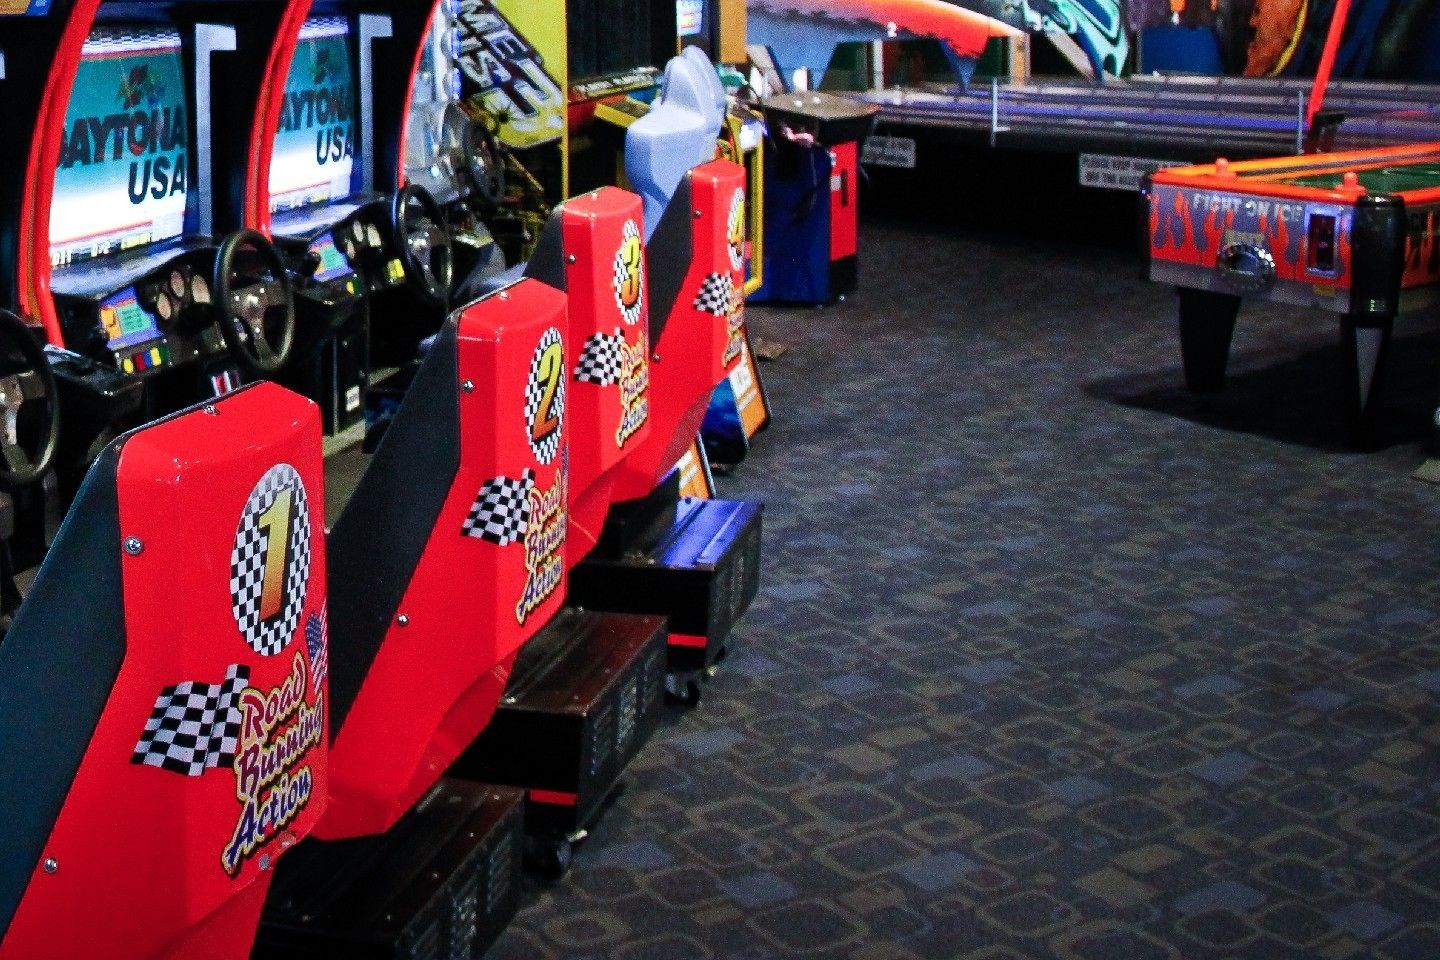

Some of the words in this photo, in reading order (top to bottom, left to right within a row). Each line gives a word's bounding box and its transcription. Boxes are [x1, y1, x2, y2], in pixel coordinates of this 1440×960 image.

[277, 86, 354, 133] AYTONA
[316, 127, 354, 166] USA
[127, 154, 186, 205] USA
[622, 238, 641, 307] 3
[533, 342, 562, 440] 2
[257, 486, 294, 625] 1
[240, 652, 307, 742] Road
[235, 693, 323, 798] Burning
[223, 767, 311, 873] Action
